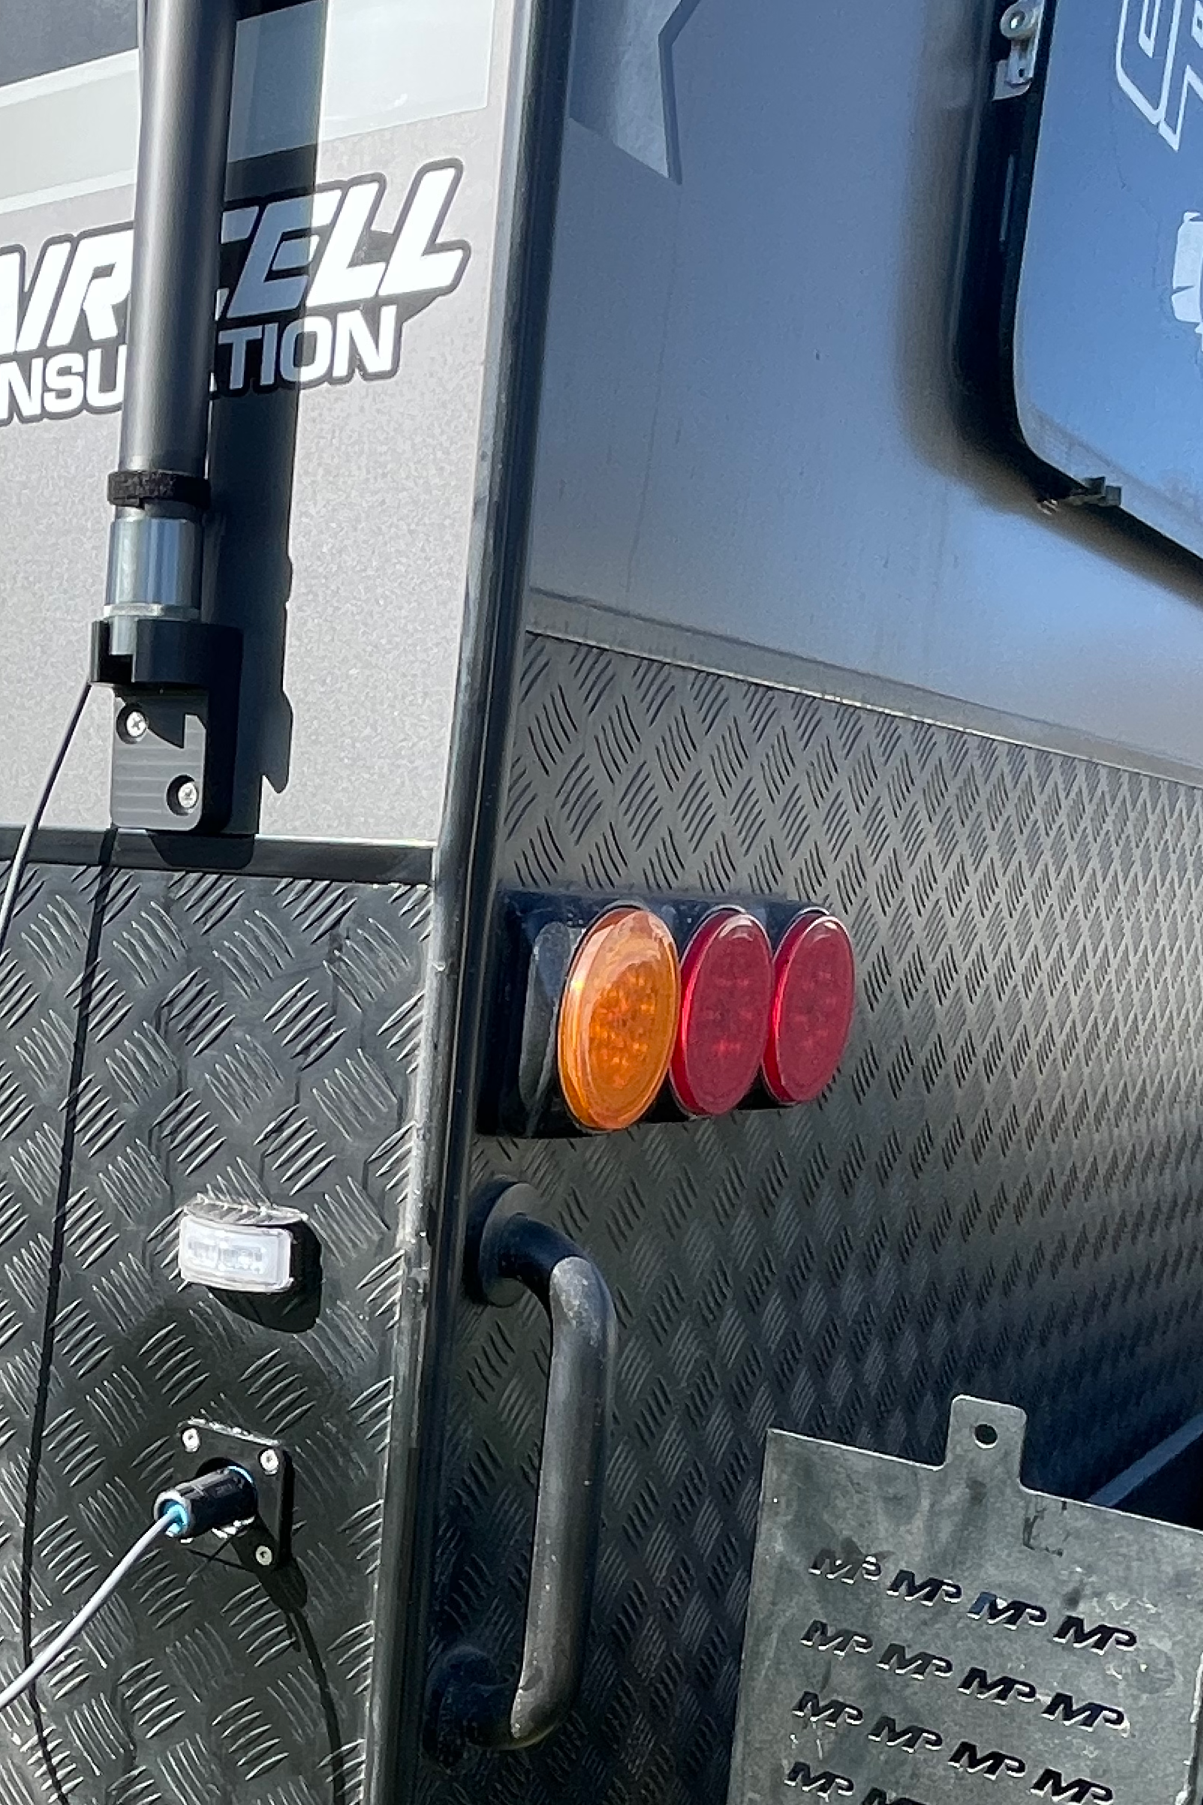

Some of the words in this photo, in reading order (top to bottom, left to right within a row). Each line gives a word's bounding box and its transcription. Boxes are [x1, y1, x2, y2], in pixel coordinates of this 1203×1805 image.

[886, 1569, 962, 1606] MP
[966, 1591, 1047, 1630] MP
[1052, 1615, 1137, 1655] MP
[800, 1619, 873, 1656] MP
[876, 1642, 953, 1680] MP
[957, 1666, 1038, 1705] MP
[1041, 1692, 1126, 1731] MP
[784, 1761, 855, 1799] MP
[792, 1690, 864, 1728] MP
[867, 1715, 943, 1752] MP
[947, 1741, 1026, 1780] MP
[1030, 1768, 1114, 1805] MP
